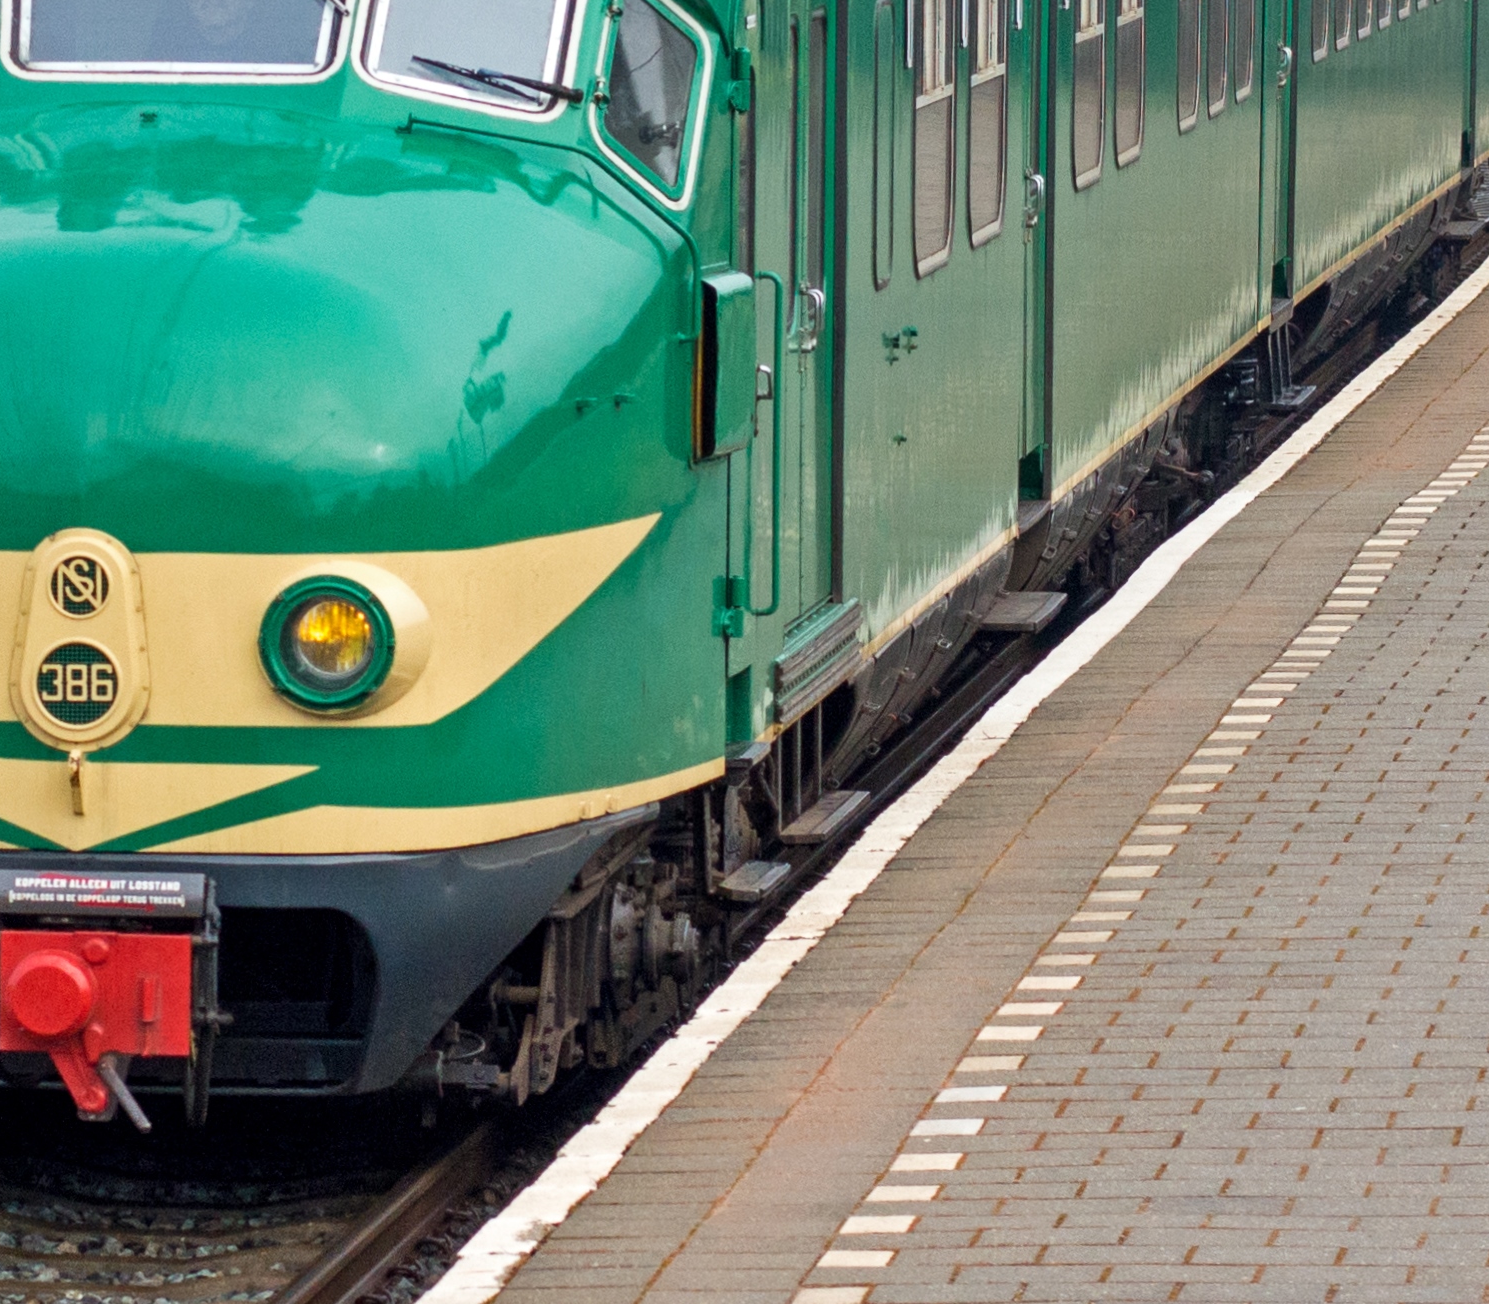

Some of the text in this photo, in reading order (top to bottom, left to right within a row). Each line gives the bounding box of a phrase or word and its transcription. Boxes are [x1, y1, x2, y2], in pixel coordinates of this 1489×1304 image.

[41, 664, 114, 702] 386
[15, 877, 181, 892] KOPPELEN ALLEEN UIT LOSSTAND
